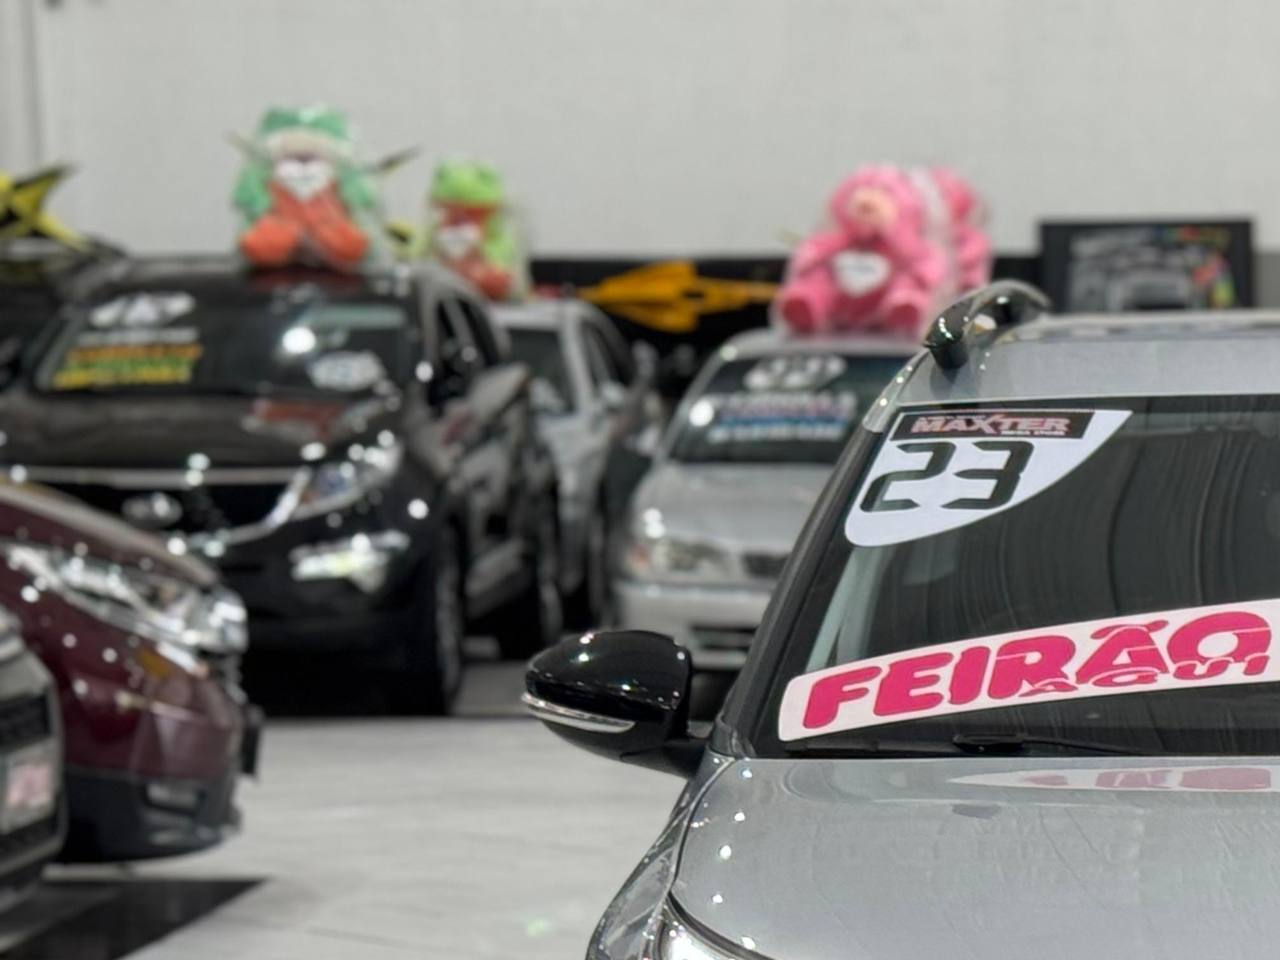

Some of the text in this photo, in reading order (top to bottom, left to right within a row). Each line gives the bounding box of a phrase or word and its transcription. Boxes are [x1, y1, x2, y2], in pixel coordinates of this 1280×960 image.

[911, 413, 1072, 435] MAXTER
[860, 440, 1036, 514] 23
[802, 611, 1272, 730] FEIRÃO
